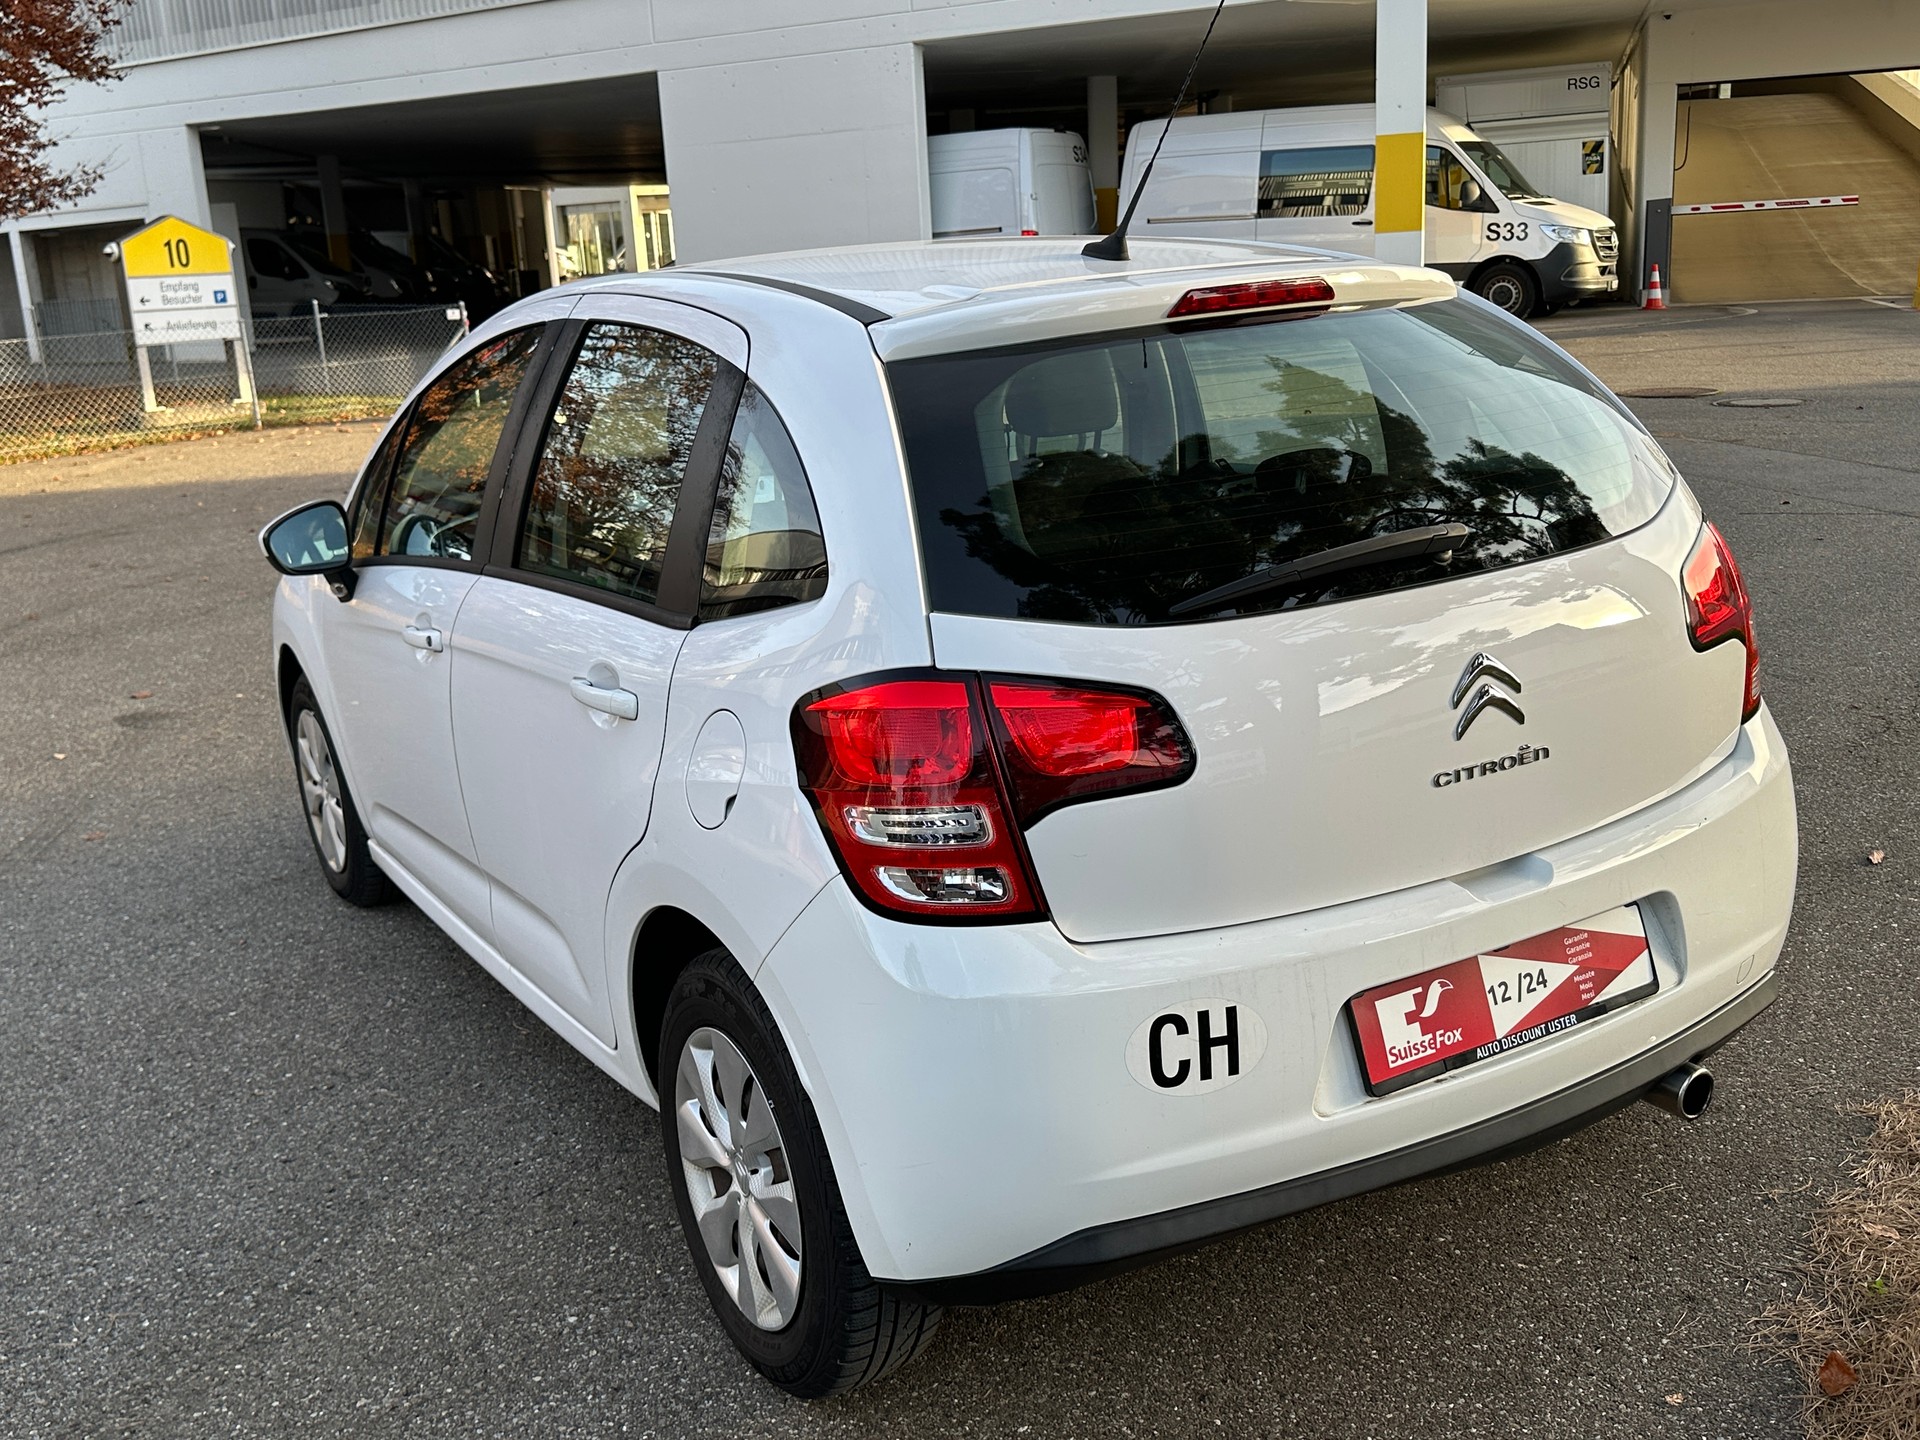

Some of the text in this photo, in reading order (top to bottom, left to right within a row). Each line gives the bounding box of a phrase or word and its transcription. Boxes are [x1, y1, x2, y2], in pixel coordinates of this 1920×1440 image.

[1567, 76, 1600, 90] RSG
[1485, 222, 1529, 241] S33
[163, 238, 191, 268] 10
[160, 281, 199, 294] Empfang
[161, 293, 203, 306] Besucher
[1432, 744, 1550, 788] CITROËN
[1564, 931, 1588, 945] Garantie
[1566, 941, 1591, 955] Garantie
[1568, 951, 1592, 964] Garanzia
[1573, 970, 1595, 983] Monate
[1580, 981, 1593, 991] Mois
[1581, 990, 1595, 1001] Mesi
[1476, 1014, 1578, 1060] AUTO DISCOUNT USTER
[1149, 1005, 1240, 1088] CH
[1388, 1027, 1463, 1064] SuisseFox
